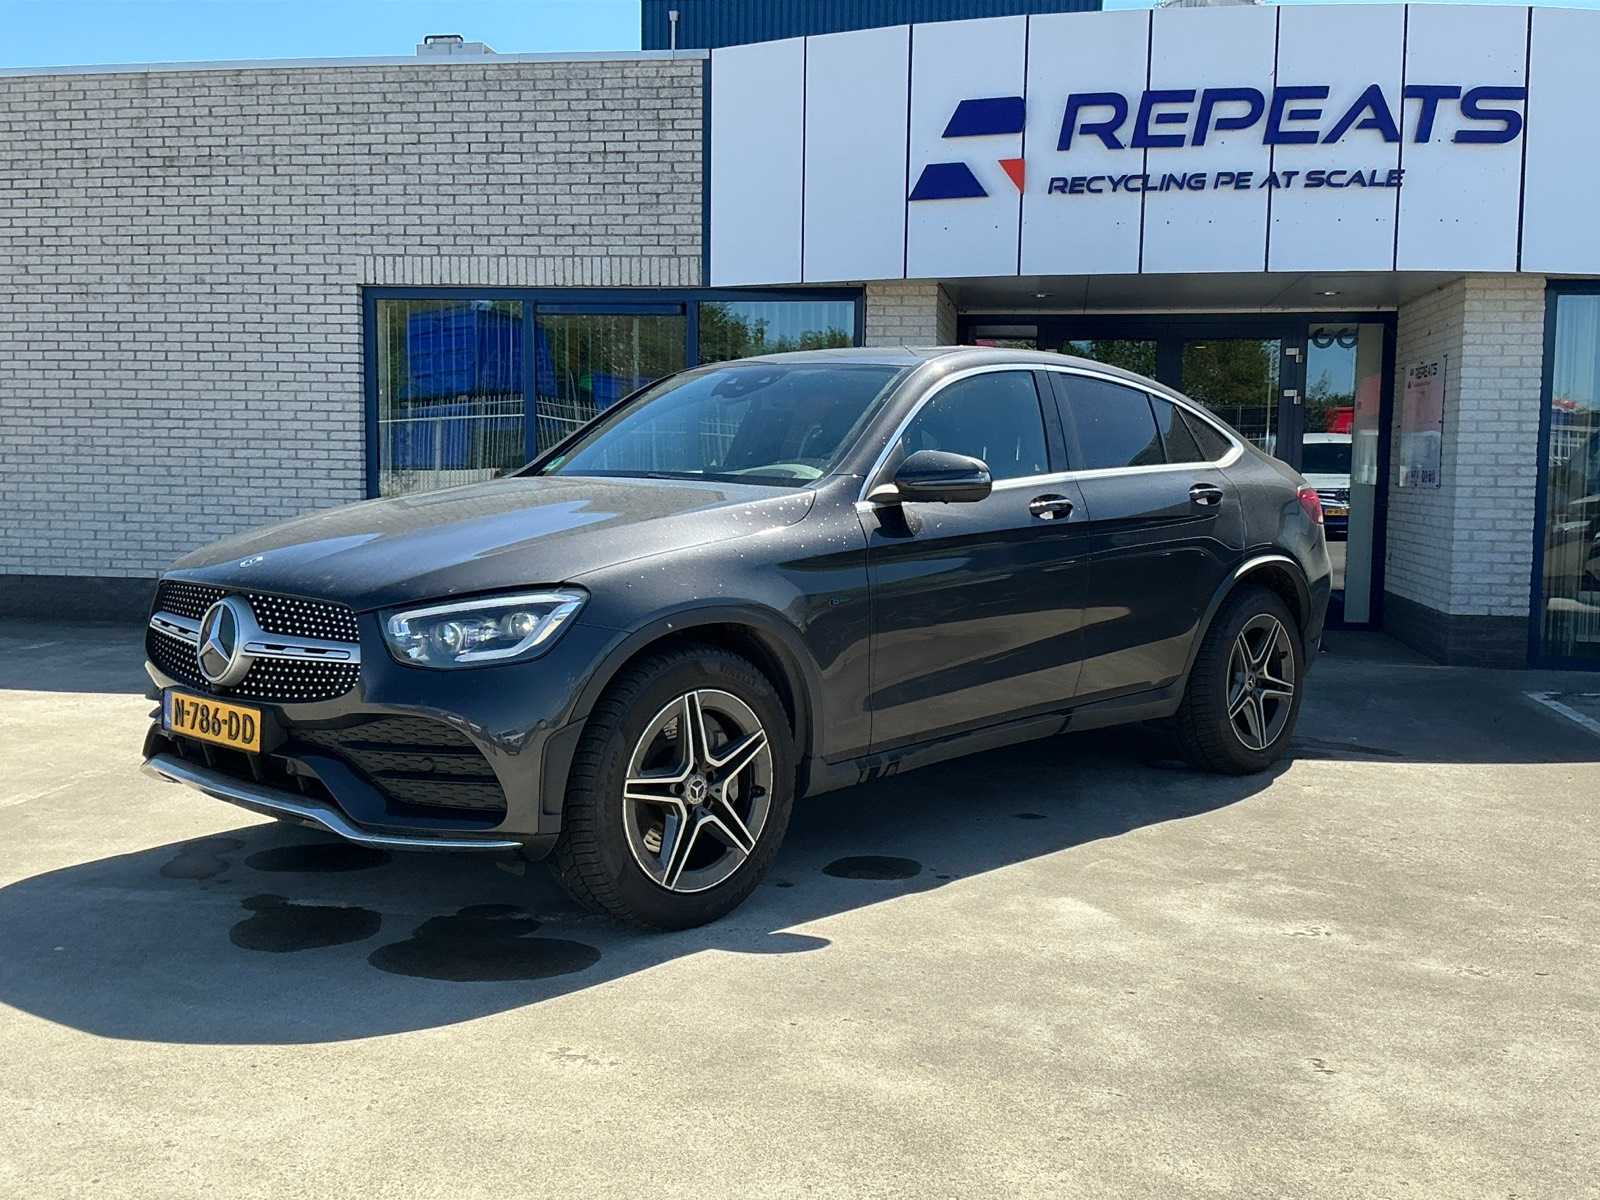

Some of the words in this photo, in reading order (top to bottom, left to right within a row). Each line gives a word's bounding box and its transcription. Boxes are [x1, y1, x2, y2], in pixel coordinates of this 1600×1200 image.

[1056, 84, 1527, 152] REPEATS
[1048, 172, 1207, 195] RECYCLING
[1213, 171, 1253, 190] PE
[1258, 170, 1300, 189] AT
[1303, 169, 1405, 188] SCALE
[174, 698, 255, 745] N-786-DD
